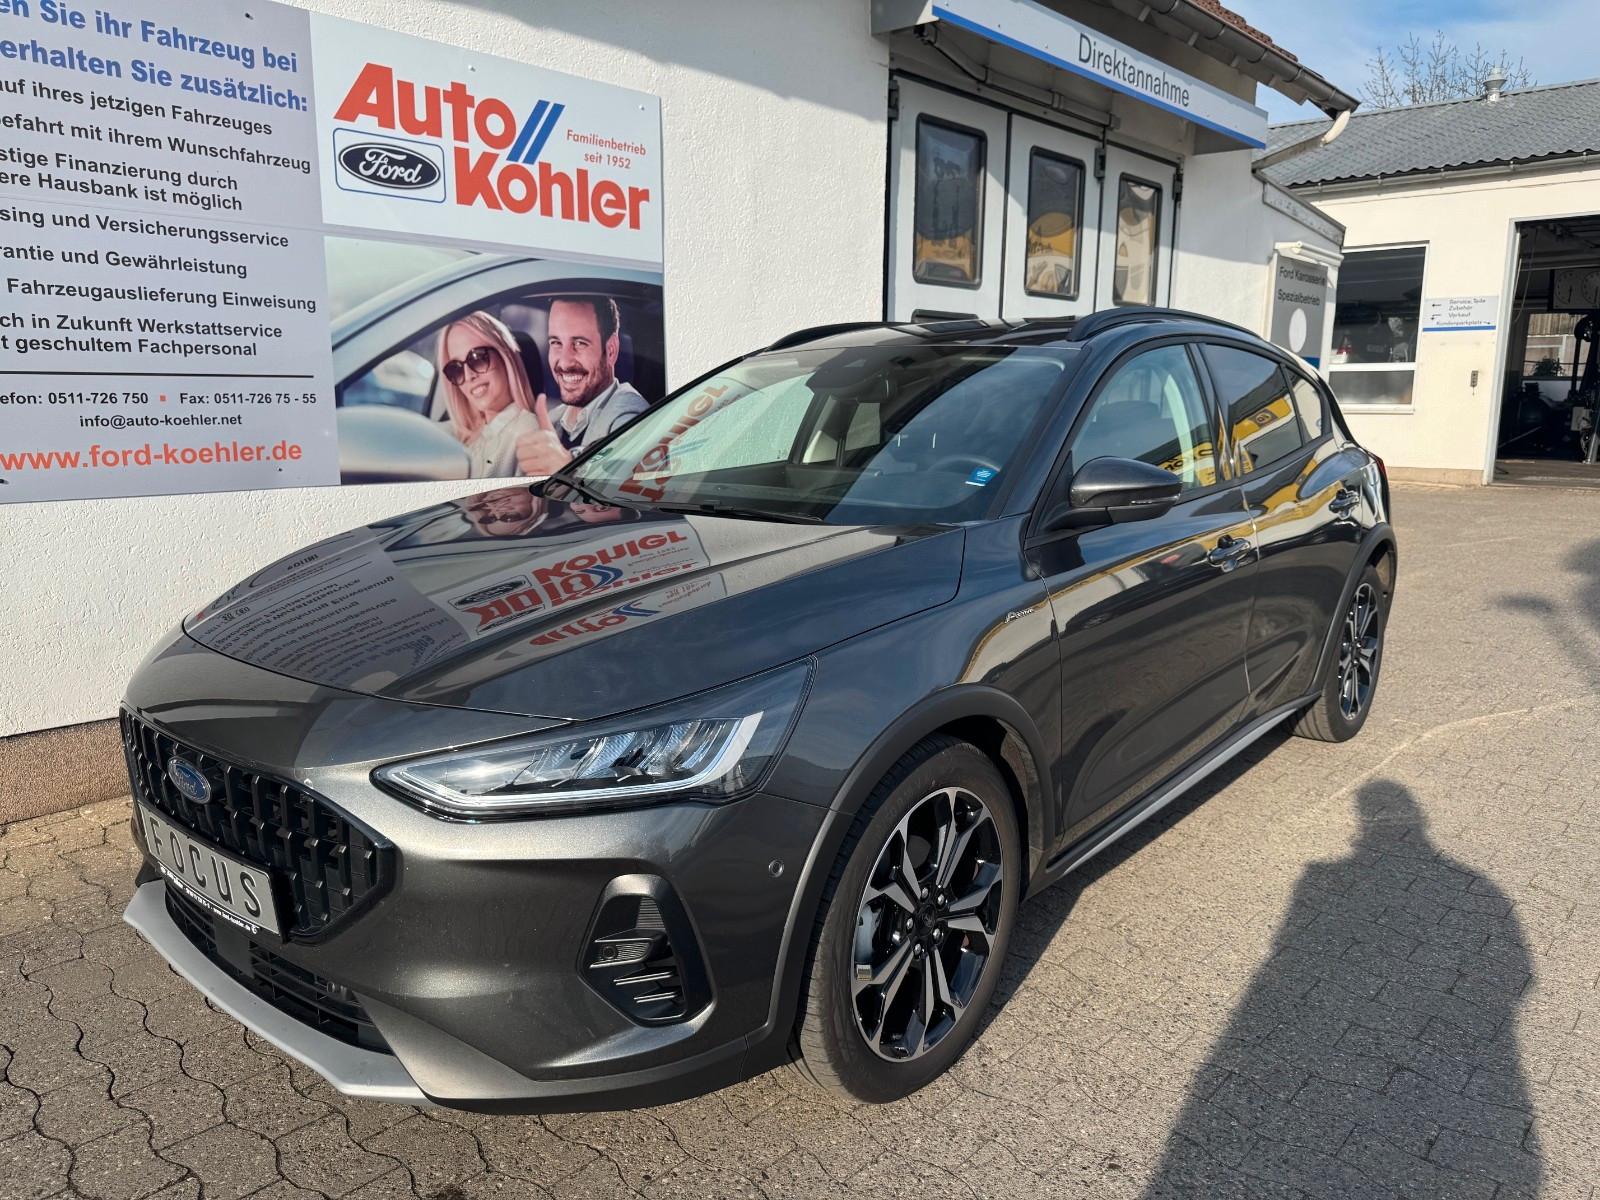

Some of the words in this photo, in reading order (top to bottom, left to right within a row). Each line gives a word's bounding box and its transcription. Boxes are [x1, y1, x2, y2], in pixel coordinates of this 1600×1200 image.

[40, 0, 86, 29] Sie
[95, 10, 132, 38] ihr
[141, 20, 255, 69] Fahrzeug
[262, 46, 297, 72] bei
[0, 40, 122, 78] erhalten
[131, 59, 172, 87] Sie
[180, 73, 308, 112] zusätzlich:
[1078, 32, 1190, 108] Direktannahme
[32, 81, 84, 104] ihres
[90, 91, 166, 118] jetzigen
[172, 105, 273, 136] Fahrzeuges
[333, 62, 517, 150] Auto
[71, 125, 102, 141] mit
[108, 128, 162, 150] ihrem
[168, 137, 311, 174] Wunschfahrzeug
[566, 129, 647, 156] Familienbetrieb
[55, 152, 182, 186] Finanzierung
[188, 172, 238, 190] durch
[358, 148, 422, 185] Ford
[584, 151, 602, 165] seit
[605, 153, 632, 170] 1952
[38, 172, 138, 200] Hausbank
[144, 186, 167, 203] ist
[173, 192, 243, 211] möglich
[52, 214, 90, 229] und
[96, 215, 289, 248] Versicherungsservice
[61, 250, 99, 265] und
[105, 251, 248, 279] Gewährleistung
[7, 278, 217, 308] Fahrzeugauslieferung
[222, 291, 317, 313] Einweisung
[31, 313, 50, 329] in
[56, 315, 133, 333] Zukunft
[138, 318, 282, 338] Werkstattservice
[15, 335, 132, 354] geschultem
[138, 338, 257, 358] Fachpersonal
[48, 392, 117, 404] 0511-726
[123, 392, 148, 405] 750
[180, 393, 209, 405] Fax:
[214, 393, 272, 405] 0511-726
[275, 393, 291, 405] 75
[304, 393, 317, 405] 55
[80, 414, 243, 430] info@auto-koehler.net
[0, 440, 302, 471] www.ford-koehler.de
[150, 818, 262, 918] FOCUS
